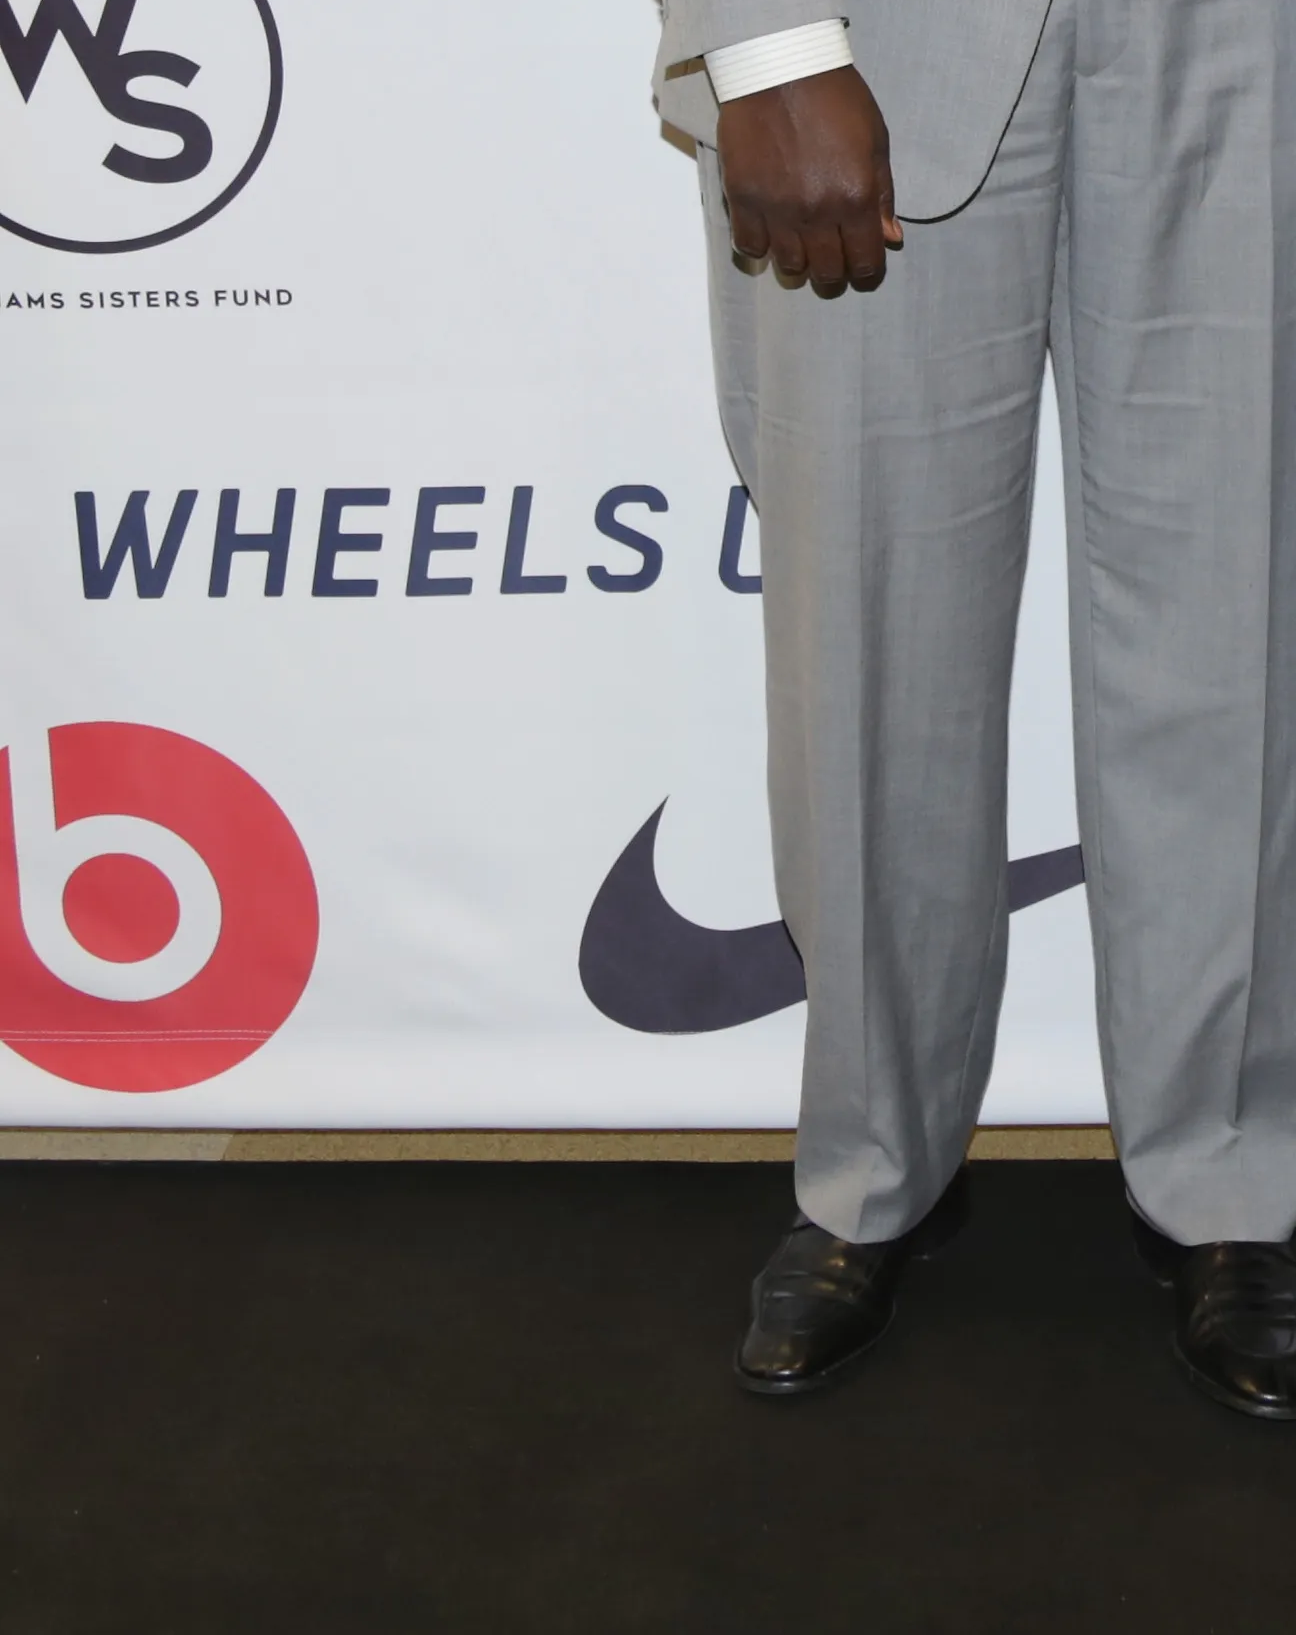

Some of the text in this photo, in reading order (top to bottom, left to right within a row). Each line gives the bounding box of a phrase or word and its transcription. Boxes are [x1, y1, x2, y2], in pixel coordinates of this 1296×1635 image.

[0, 289, 293, 309] AMS SISTERS FUND
[74, 484, 670, 599] WHEELS
